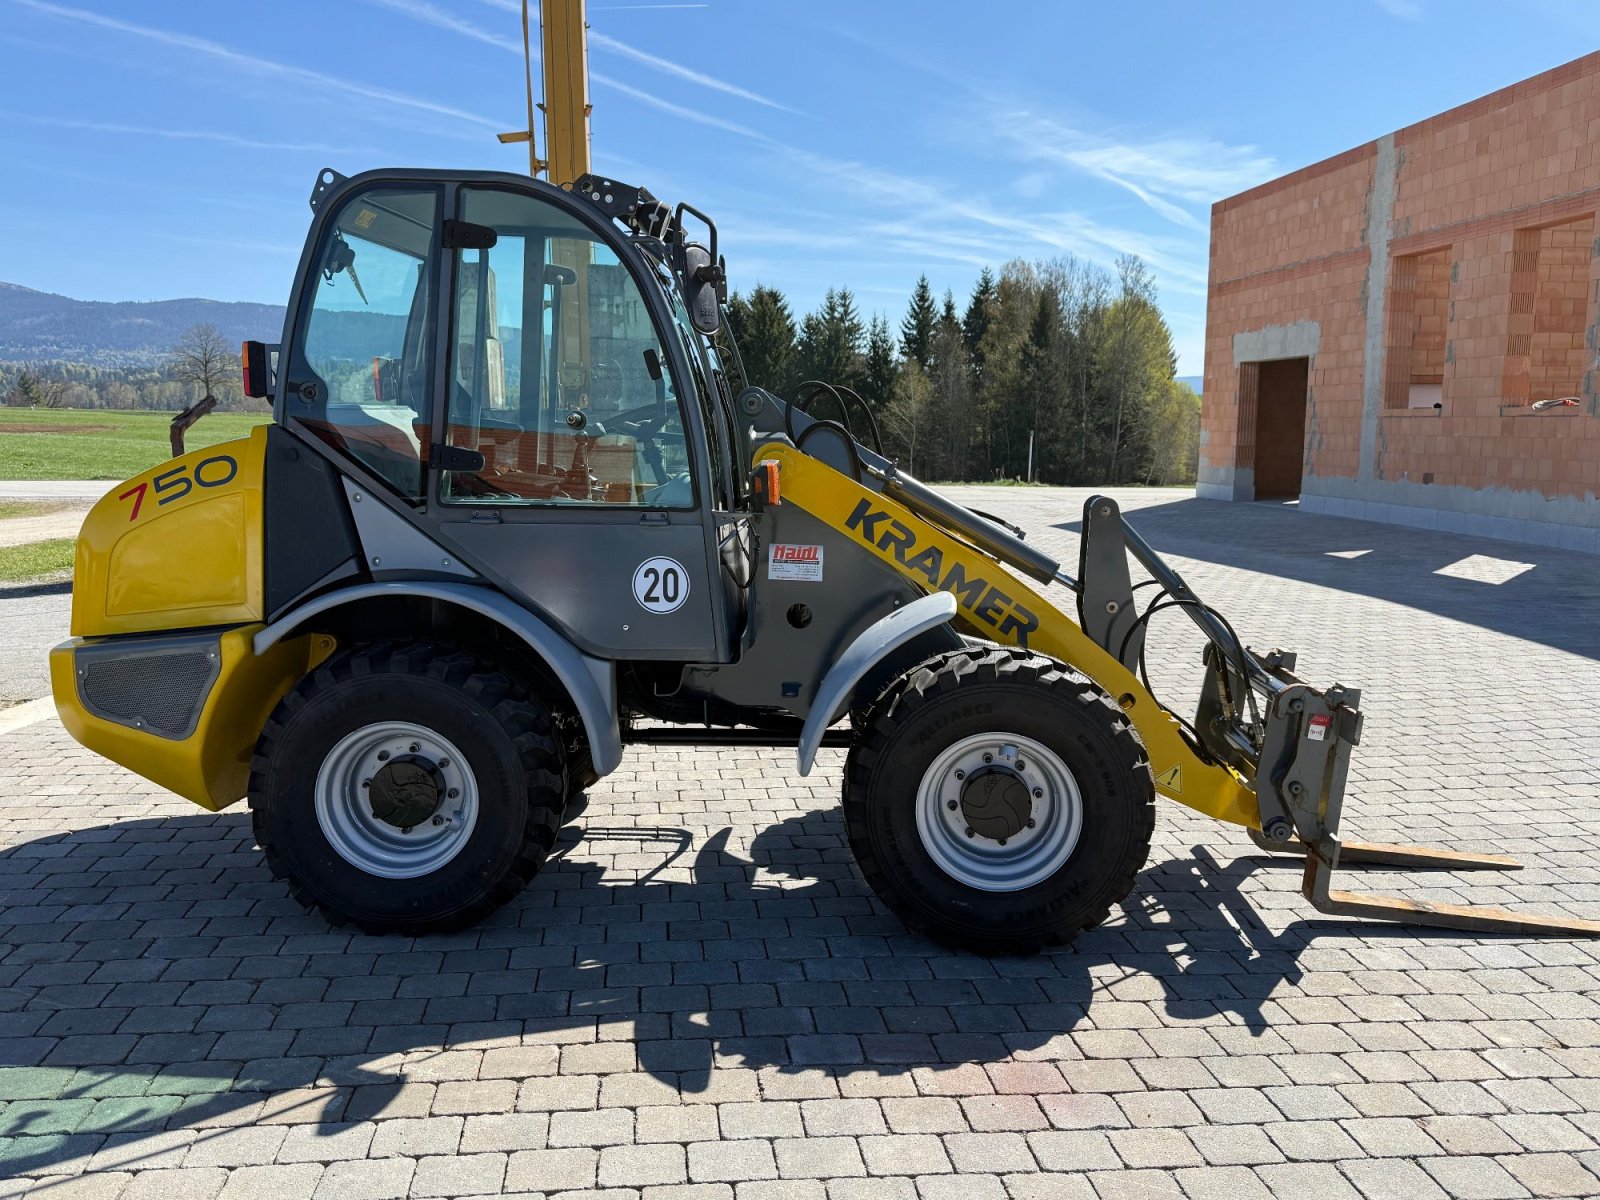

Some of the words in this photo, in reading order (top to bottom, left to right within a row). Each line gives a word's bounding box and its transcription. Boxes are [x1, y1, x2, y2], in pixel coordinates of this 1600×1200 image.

[118, 455, 238, 522] 750
[643, 567, 679, 603] 20
[844, 497, 1040, 648] KRAMER
[918, 703, 994, 747] ALLIANCE
